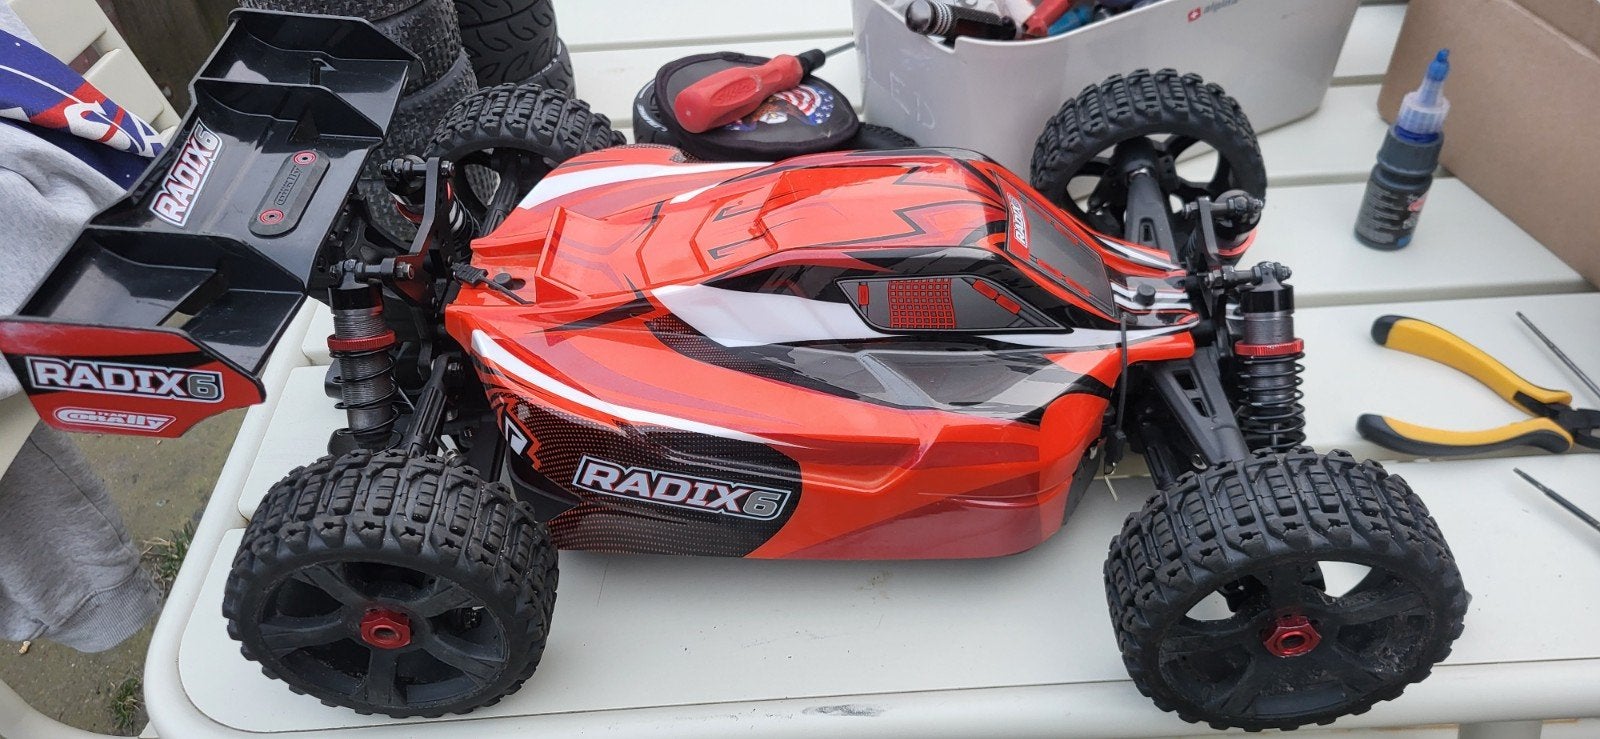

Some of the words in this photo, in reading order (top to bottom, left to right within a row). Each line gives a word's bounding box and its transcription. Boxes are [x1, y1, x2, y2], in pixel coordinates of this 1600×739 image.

[155, 122, 220, 223] RADIX6
[33, 361, 219, 400] RADIX6
[580, 461, 782, 517] RADIX6
